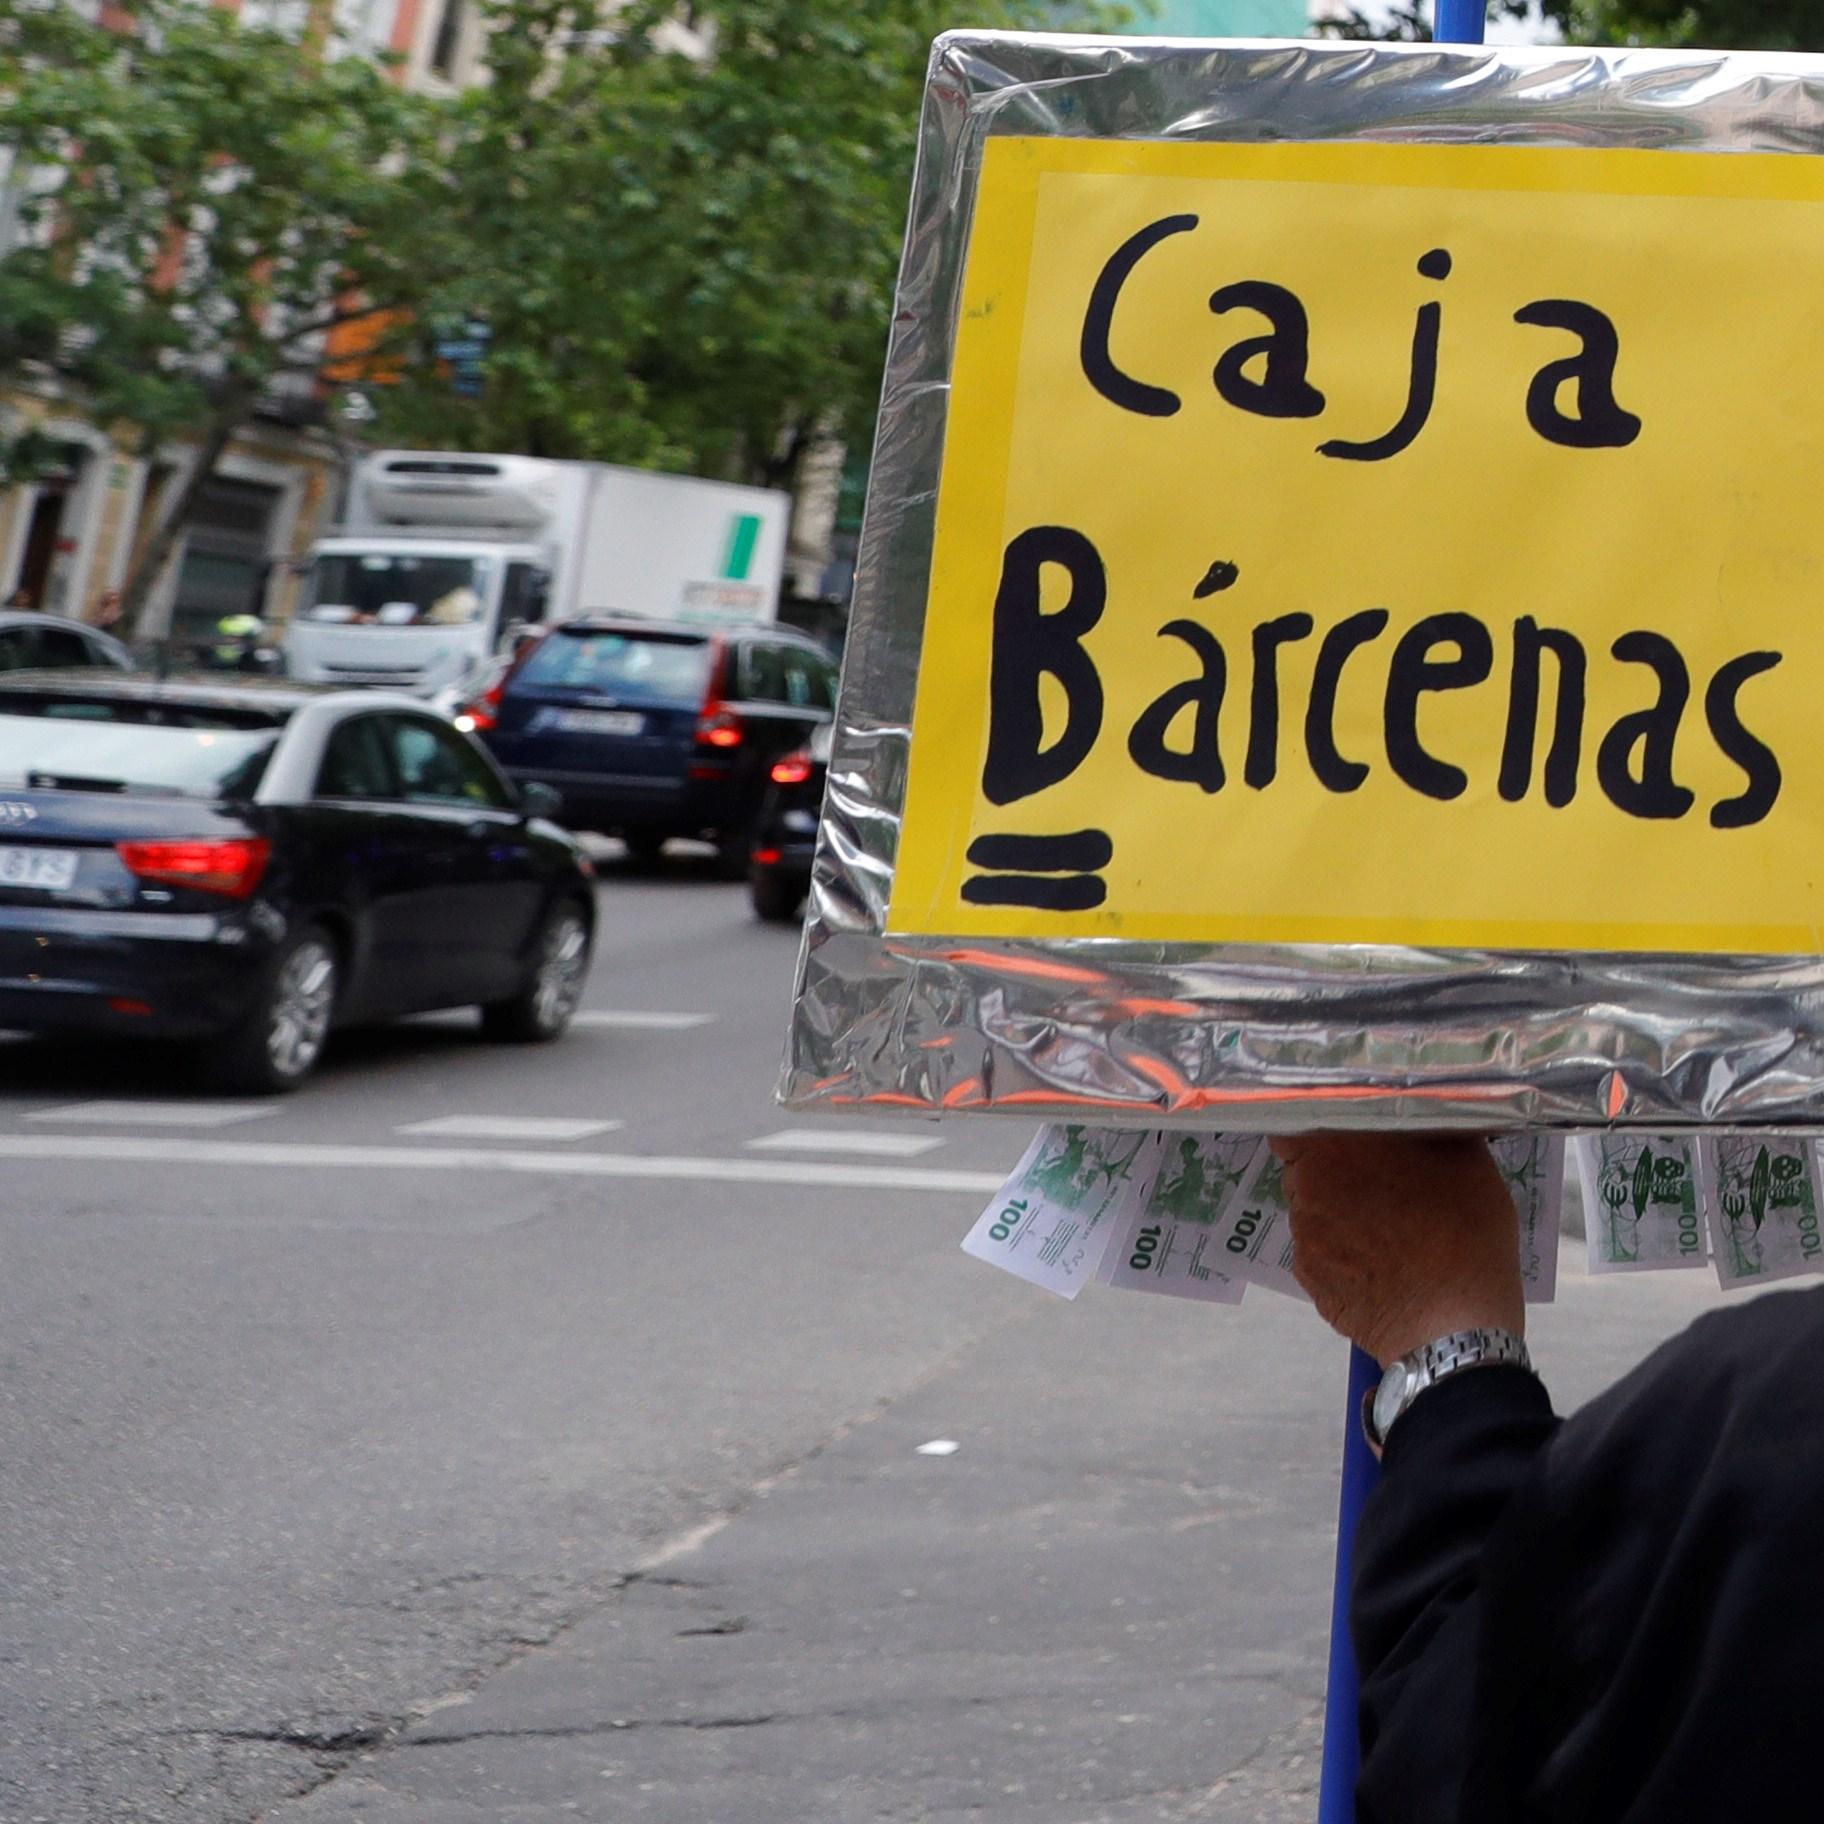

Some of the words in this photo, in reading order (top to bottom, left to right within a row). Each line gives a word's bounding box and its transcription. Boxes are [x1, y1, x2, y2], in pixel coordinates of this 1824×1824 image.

[1079, 212, 1643, 462] Caja
[978, 523, 1784, 830] Bárcenas
[988, 1197, 1029, 1242] 100
[1226, 1208, 1262, 1254] 100
[1678, 1213, 1699, 1257] 100
[1798, 1214, 1824, 1261] 100
[1129, 1224, 1162, 1271] 100
